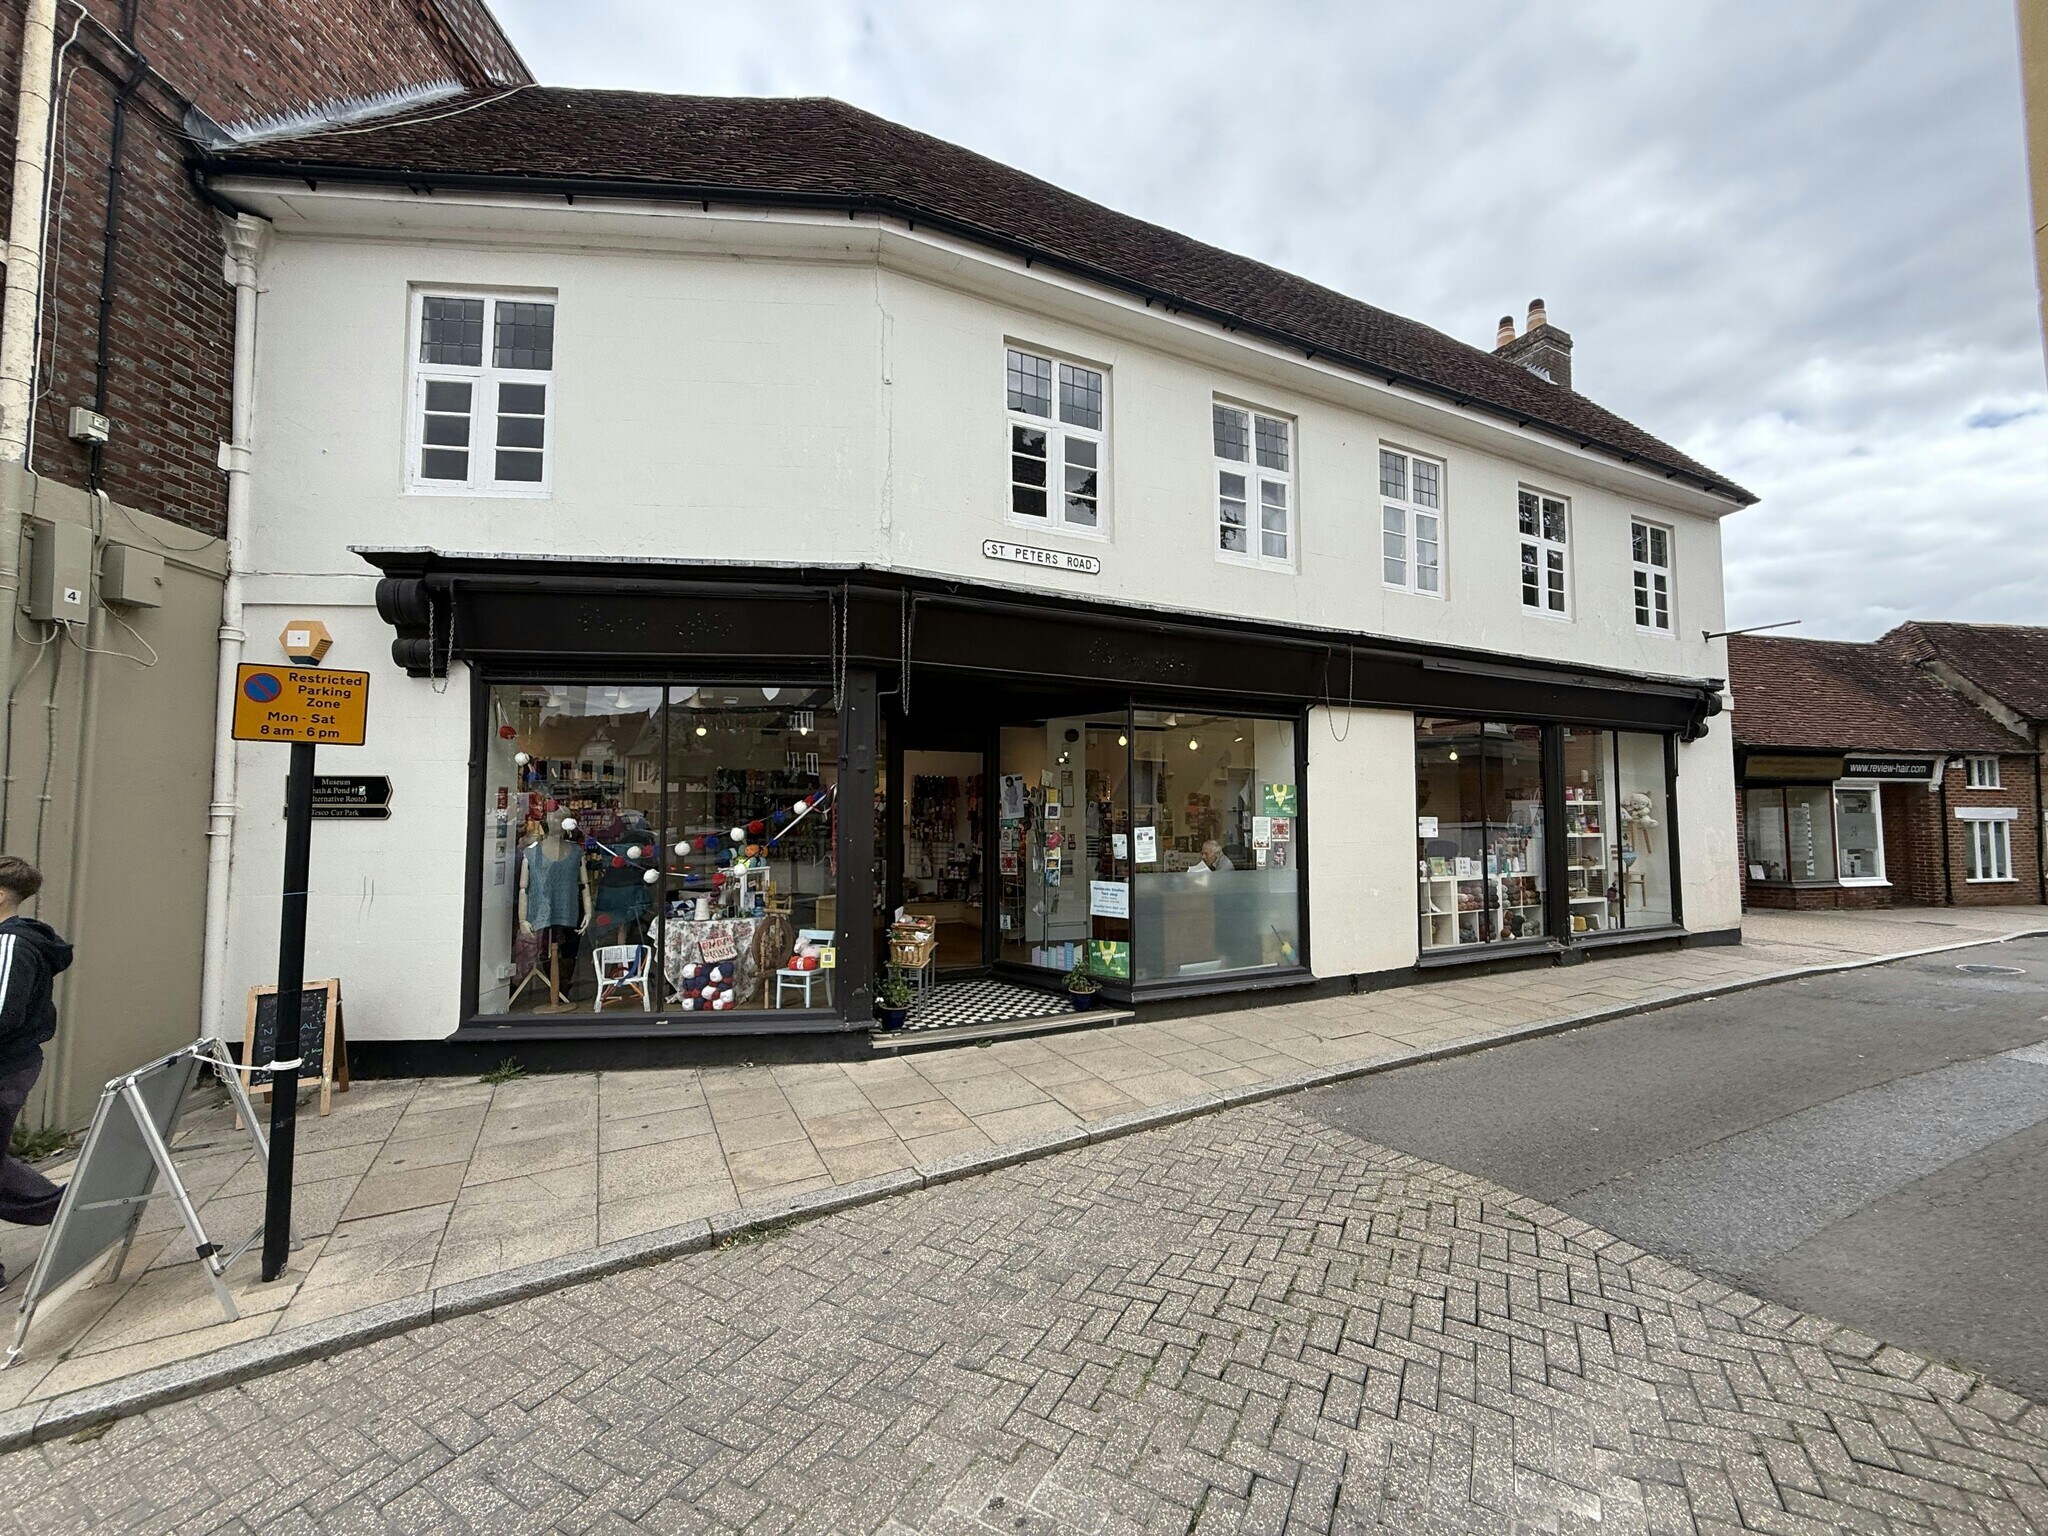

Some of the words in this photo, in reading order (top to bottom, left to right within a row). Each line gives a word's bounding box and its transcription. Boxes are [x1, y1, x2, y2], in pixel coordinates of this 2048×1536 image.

[1015, 548, 1058, 564] PETERS
[1067, 557, 1092, 570] ROAD
[67, 591, 77, 601] 4
[288, 672, 362, 686] Restricted
[298, 685, 351, 699] Parking
[306, 697, 341, 709] Zone
[267, 711, 298, 722] Mon
[310, 714, 335, 724] Sat
[260, 725, 269, 735] 8
[273, 727, 294, 736] am
[306, 727, 315, 737] 6
[319, 729, 340, 739] pm
[1850, 763, 1926, 774] www.review-hair.com
